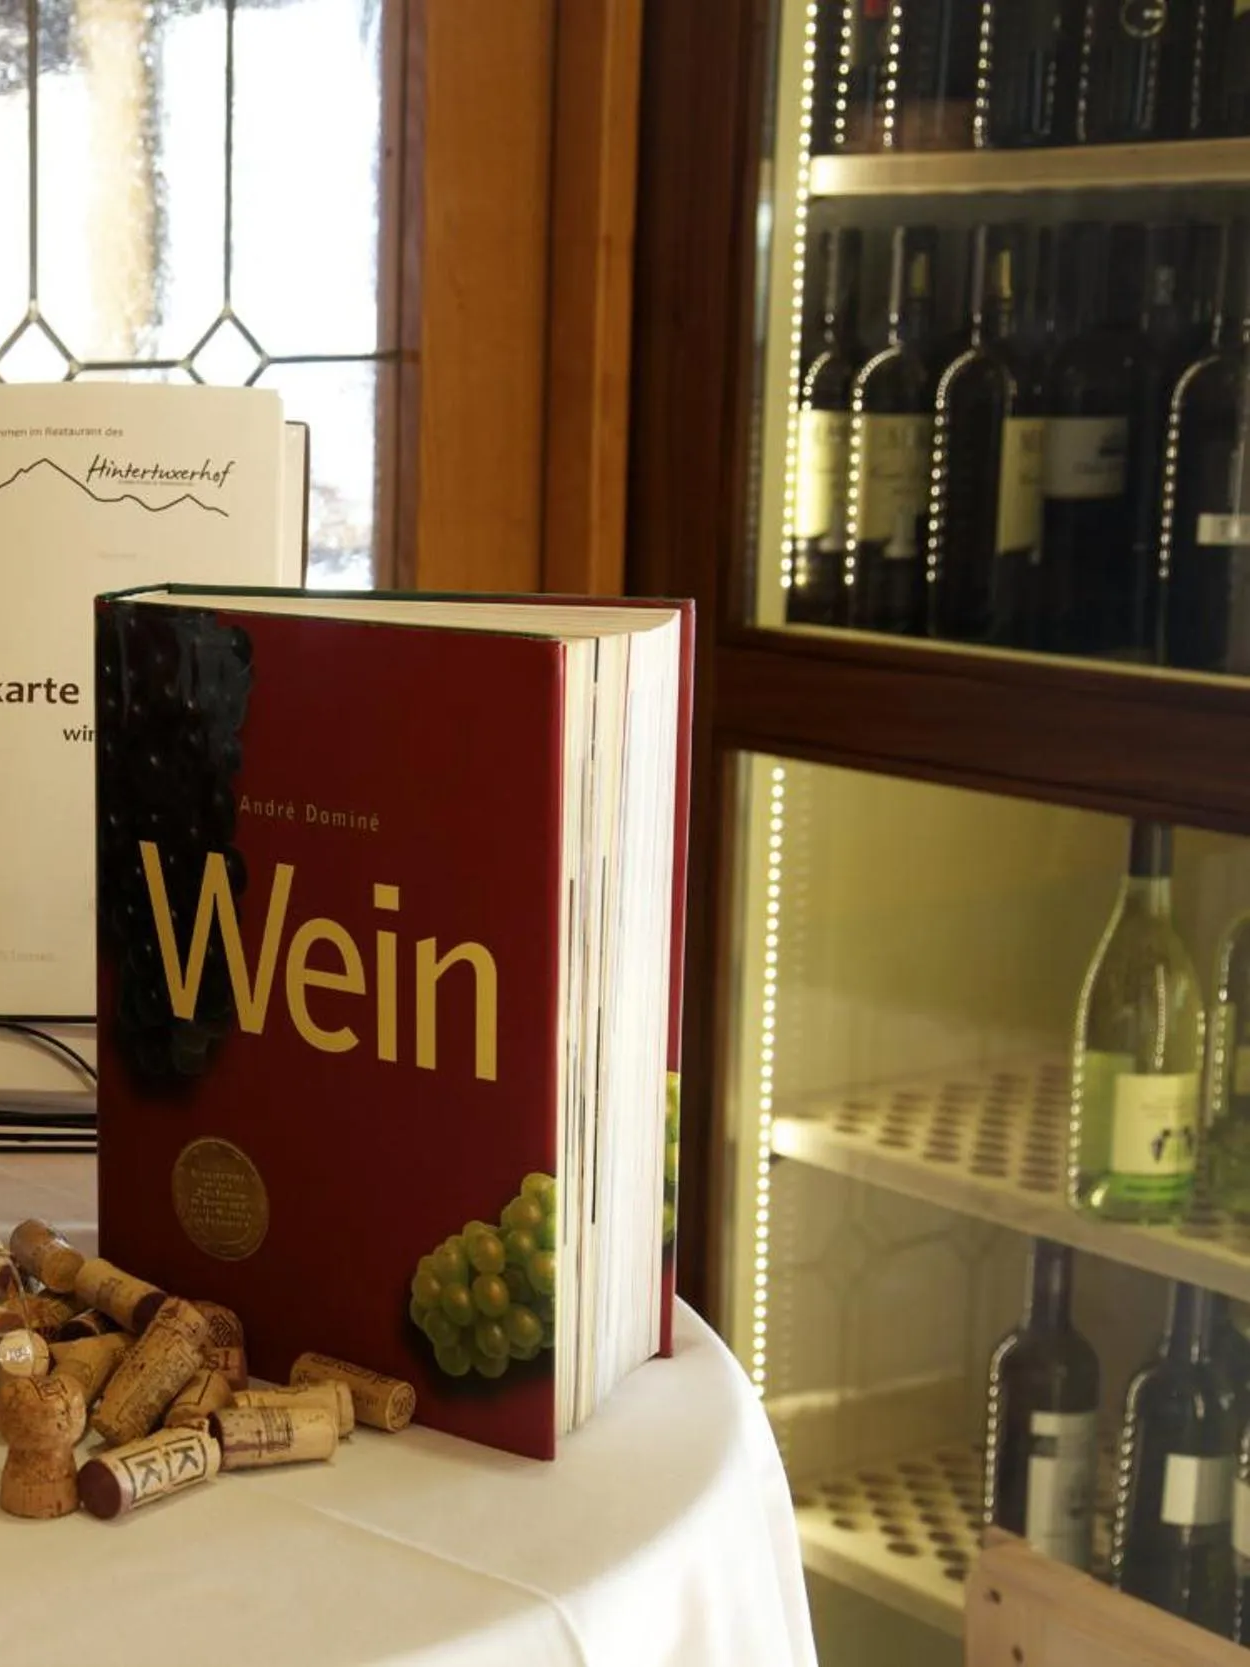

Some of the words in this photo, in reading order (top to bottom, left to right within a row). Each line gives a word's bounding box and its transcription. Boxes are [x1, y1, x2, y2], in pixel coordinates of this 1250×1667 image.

[29, 427, 42, 437] im
[45, 427, 102, 437] Restaurant
[105, 426, 124, 438] des
[86, 454, 236, 488] Hintertuxerhof
[138, 839, 498, 1082] Wein
